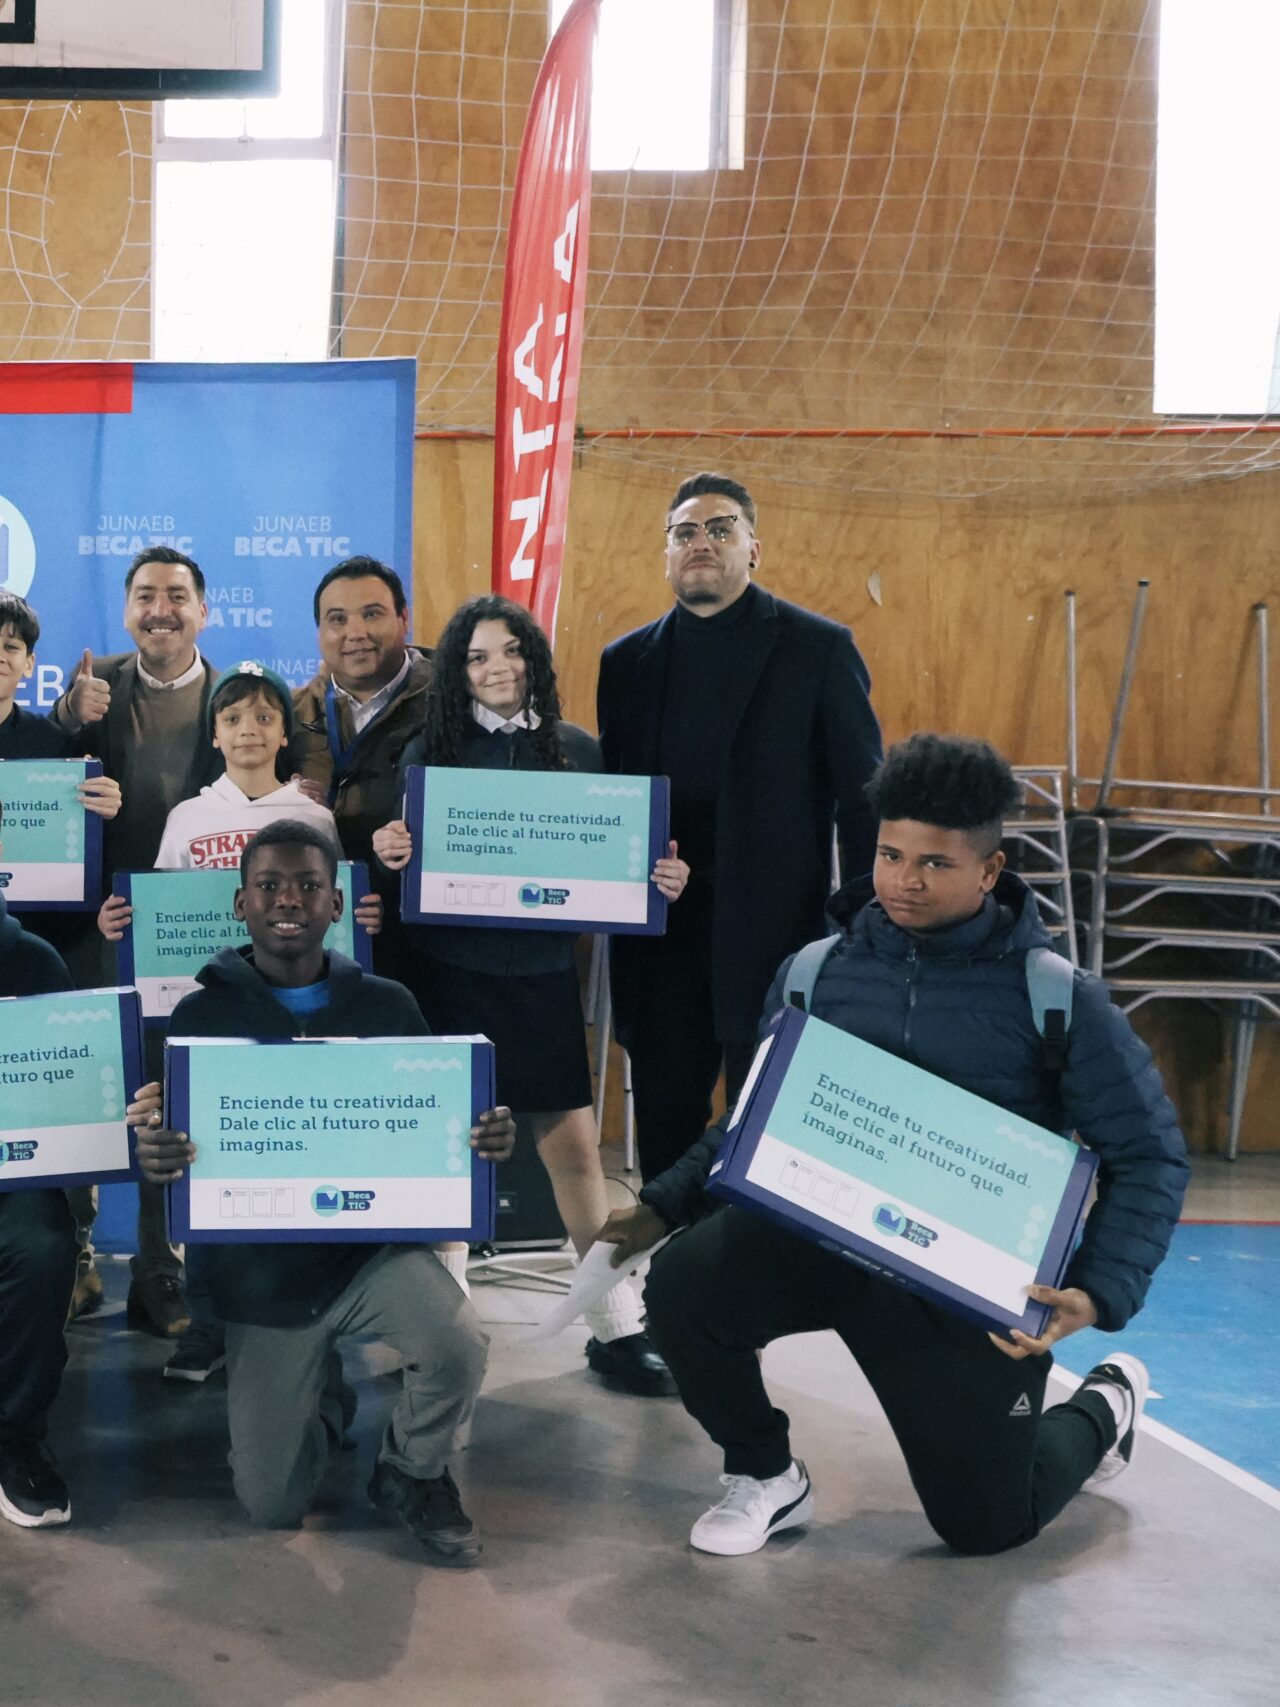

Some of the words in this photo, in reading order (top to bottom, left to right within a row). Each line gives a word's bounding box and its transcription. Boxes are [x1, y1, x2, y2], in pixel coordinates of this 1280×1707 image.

[97, 515, 175, 532] JUNAEB
[253, 516, 332, 532] JUNAEB
[78, 535, 146, 555] BECA
[234, 536, 302, 557] BECA
[305, 536, 350, 557] TIC
[204, 587, 254, 603] NAEB
[228, 608, 273, 628] TIC
[1, 800, 62, 812] atividad.
[21, 817, 45, 829] que
[448, 808, 515, 822] Enciende
[520, 811, 534, 822] tu
[539, 812, 624, 826] creatividad.
[447, 825, 478, 837] Dale
[483, 825, 508, 838] clic
[512, 827, 524, 839] al
[529, 829, 575, 841] futuro
[579, 832, 606, 844] que
[447, 841, 517, 855] imaginas.
[156, 911, 220, 923] Enciende
[157, 929, 187, 939] Dale
[191, 927, 215, 938] clic
[220, 925, 232, 937] al
[43, 1068, 74, 1085] que
[220, 1096, 304, 1110] Enciende
[310, 1096, 327, 1109] tu
[333, 1095, 440, 1110] creatividad.
[220, 1117, 259, 1131] Dale
[264, 1116, 296, 1130] clic
[301, 1116, 316, 1130] al
[322, 1116, 379, 1130] futuro
[385, 1118, 418, 1133] que
[816, 1073, 899, 1124] Enciende
[904, 1115, 923, 1134] tu
[926, 1128, 1031, 1188] creatividad.
[802, 1110, 889, 1164] imaginas.
[809, 1091, 850, 1122] Dale
[853, 1110, 886, 1139] clic
[889, 1131, 905, 1148] al
[909, 1139, 966, 1178] futuro
[970, 1173, 1005, 1198] que
[13, 1141, 33, 1150] Beca
[220, 1138, 308, 1154] imaginas.
[13, 1151, 29, 1159] TIC
[348, 1202, 366, 1210] TIC
